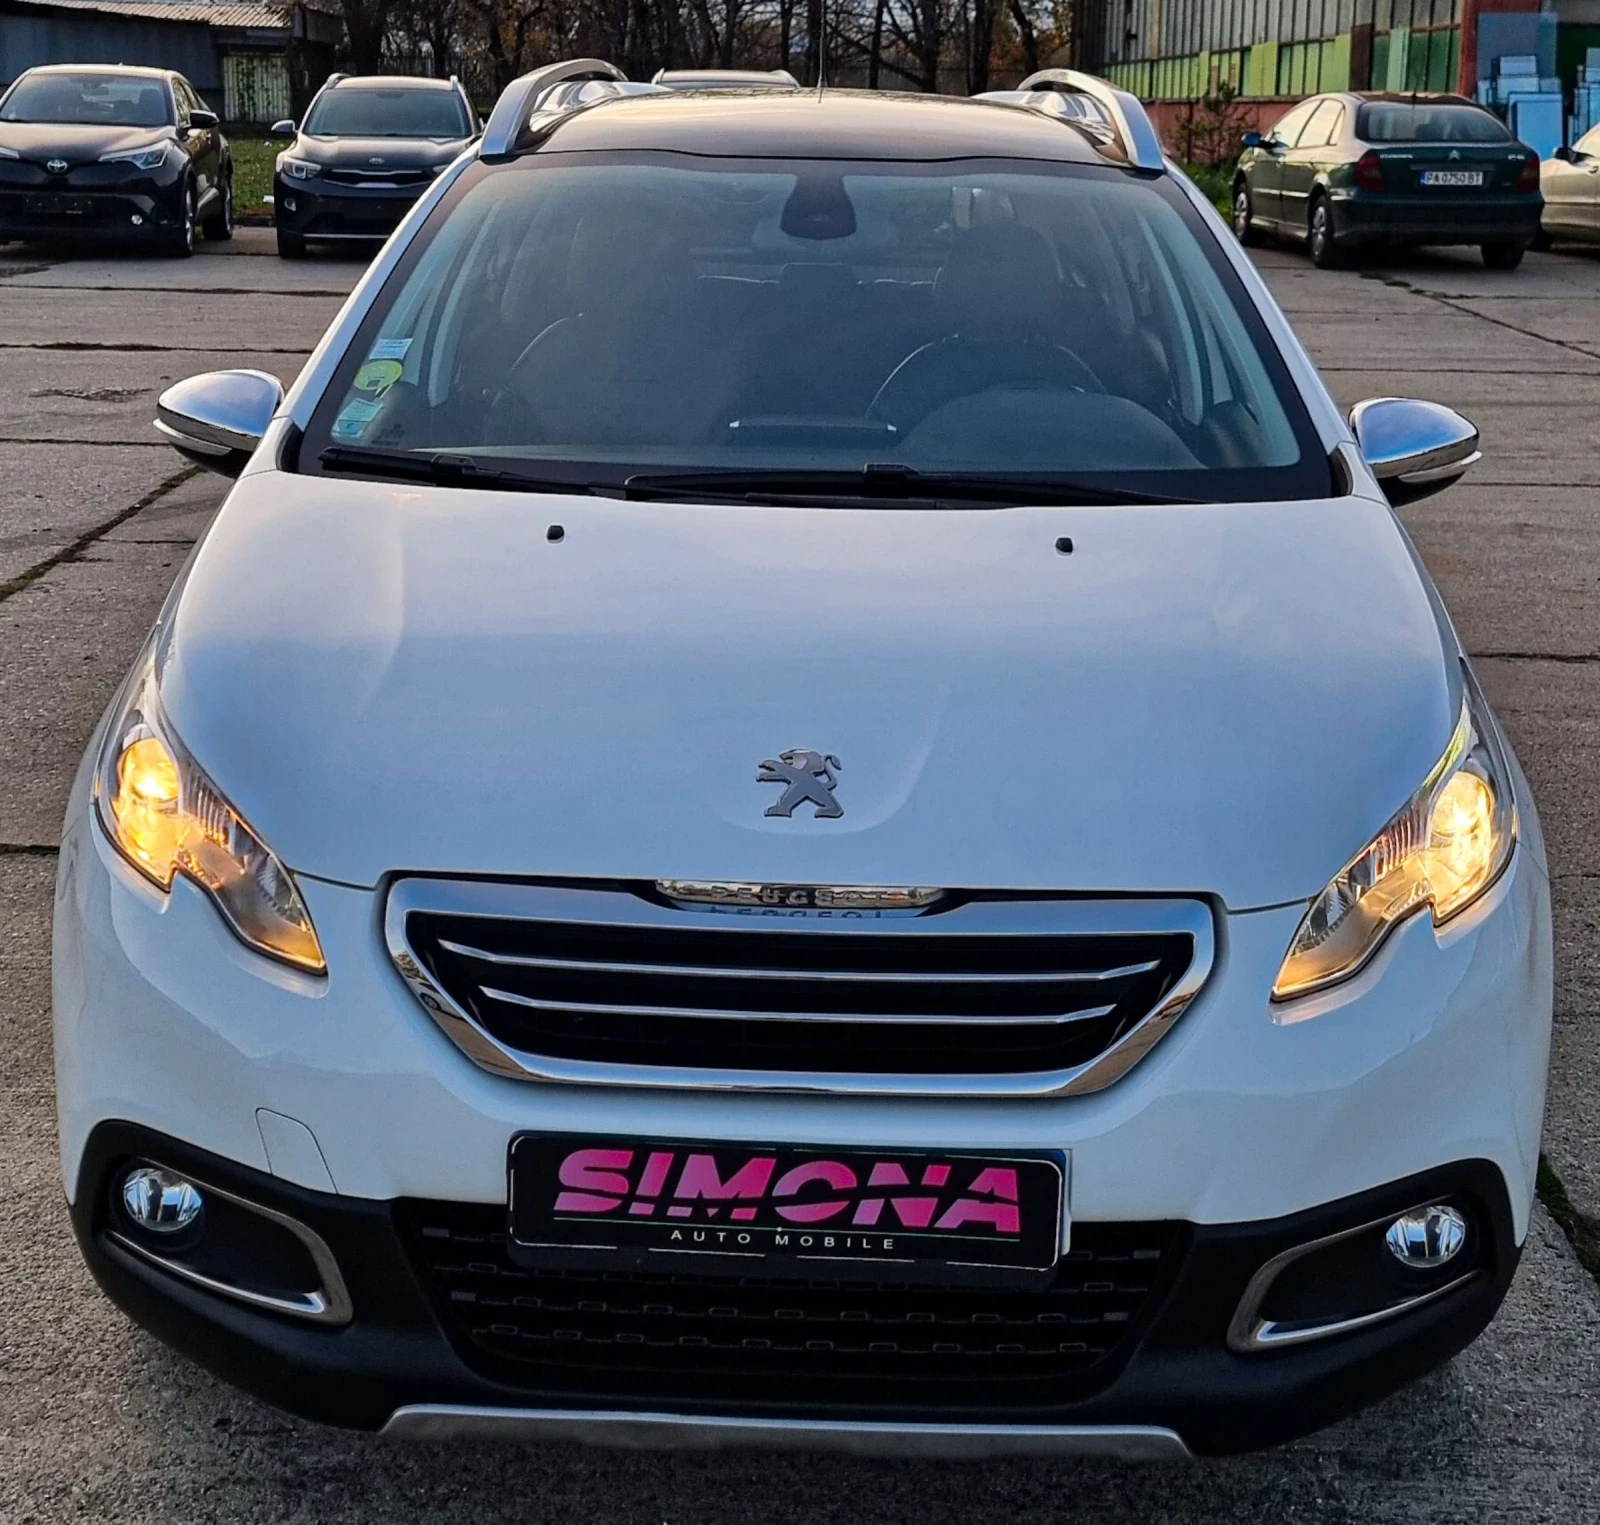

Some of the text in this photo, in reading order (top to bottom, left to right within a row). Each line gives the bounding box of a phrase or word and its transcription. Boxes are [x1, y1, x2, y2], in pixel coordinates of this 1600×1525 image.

[710, 885, 887, 906] PEUGEOT
[554, 1149, 1021, 1232] SIMONA
[670, 1230, 894, 1249] AUTO MOBILE
